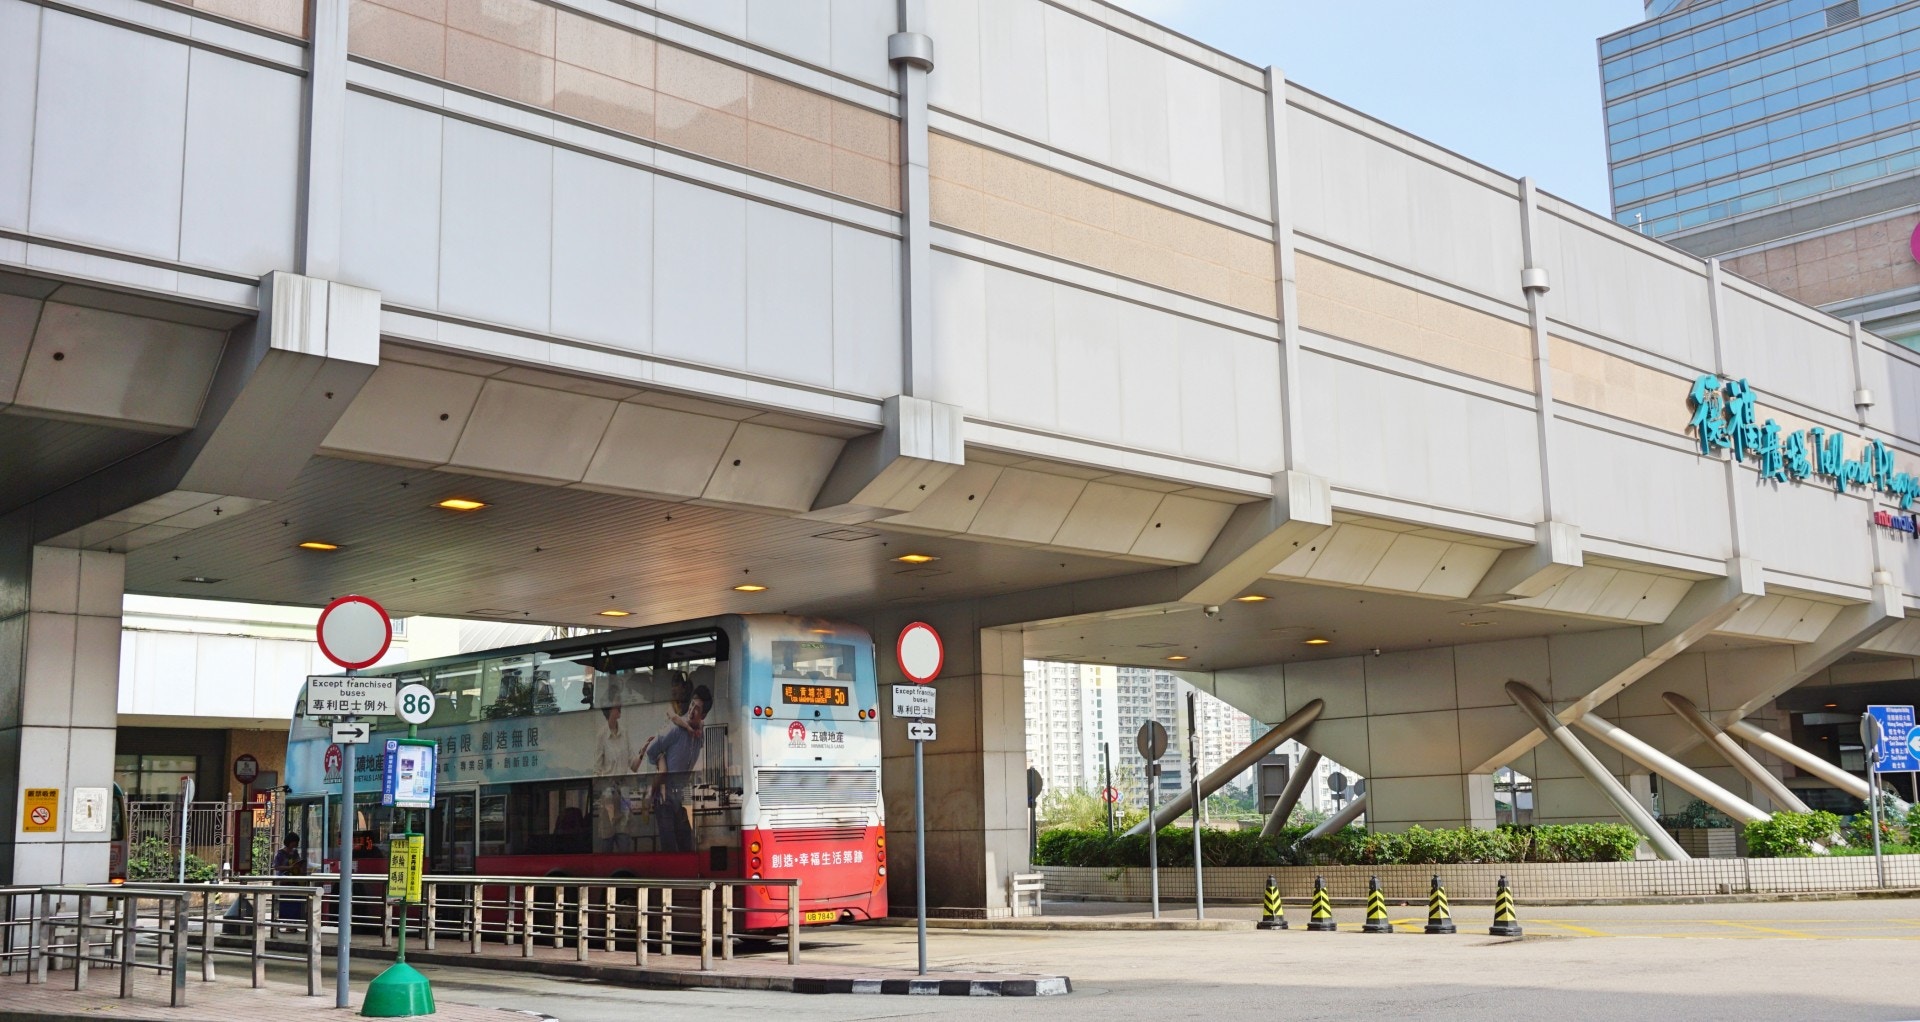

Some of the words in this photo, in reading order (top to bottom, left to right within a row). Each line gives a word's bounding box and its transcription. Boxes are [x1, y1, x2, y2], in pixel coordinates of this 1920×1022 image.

[312, 679, 343, 689] Except
[347, 680, 392, 689] franchised
[340, 689, 366, 697] buses
[895, 687, 916, 696] Except
[312, 699, 388, 711] 專利巴士例外
[402, 693, 431, 715] 86
[482, 727, 539, 751] 創造無限
[811, 731, 844, 743] 五礦地產
[354, 753, 384, 773] 礦地產
[817, 912, 834, 920] 7843
